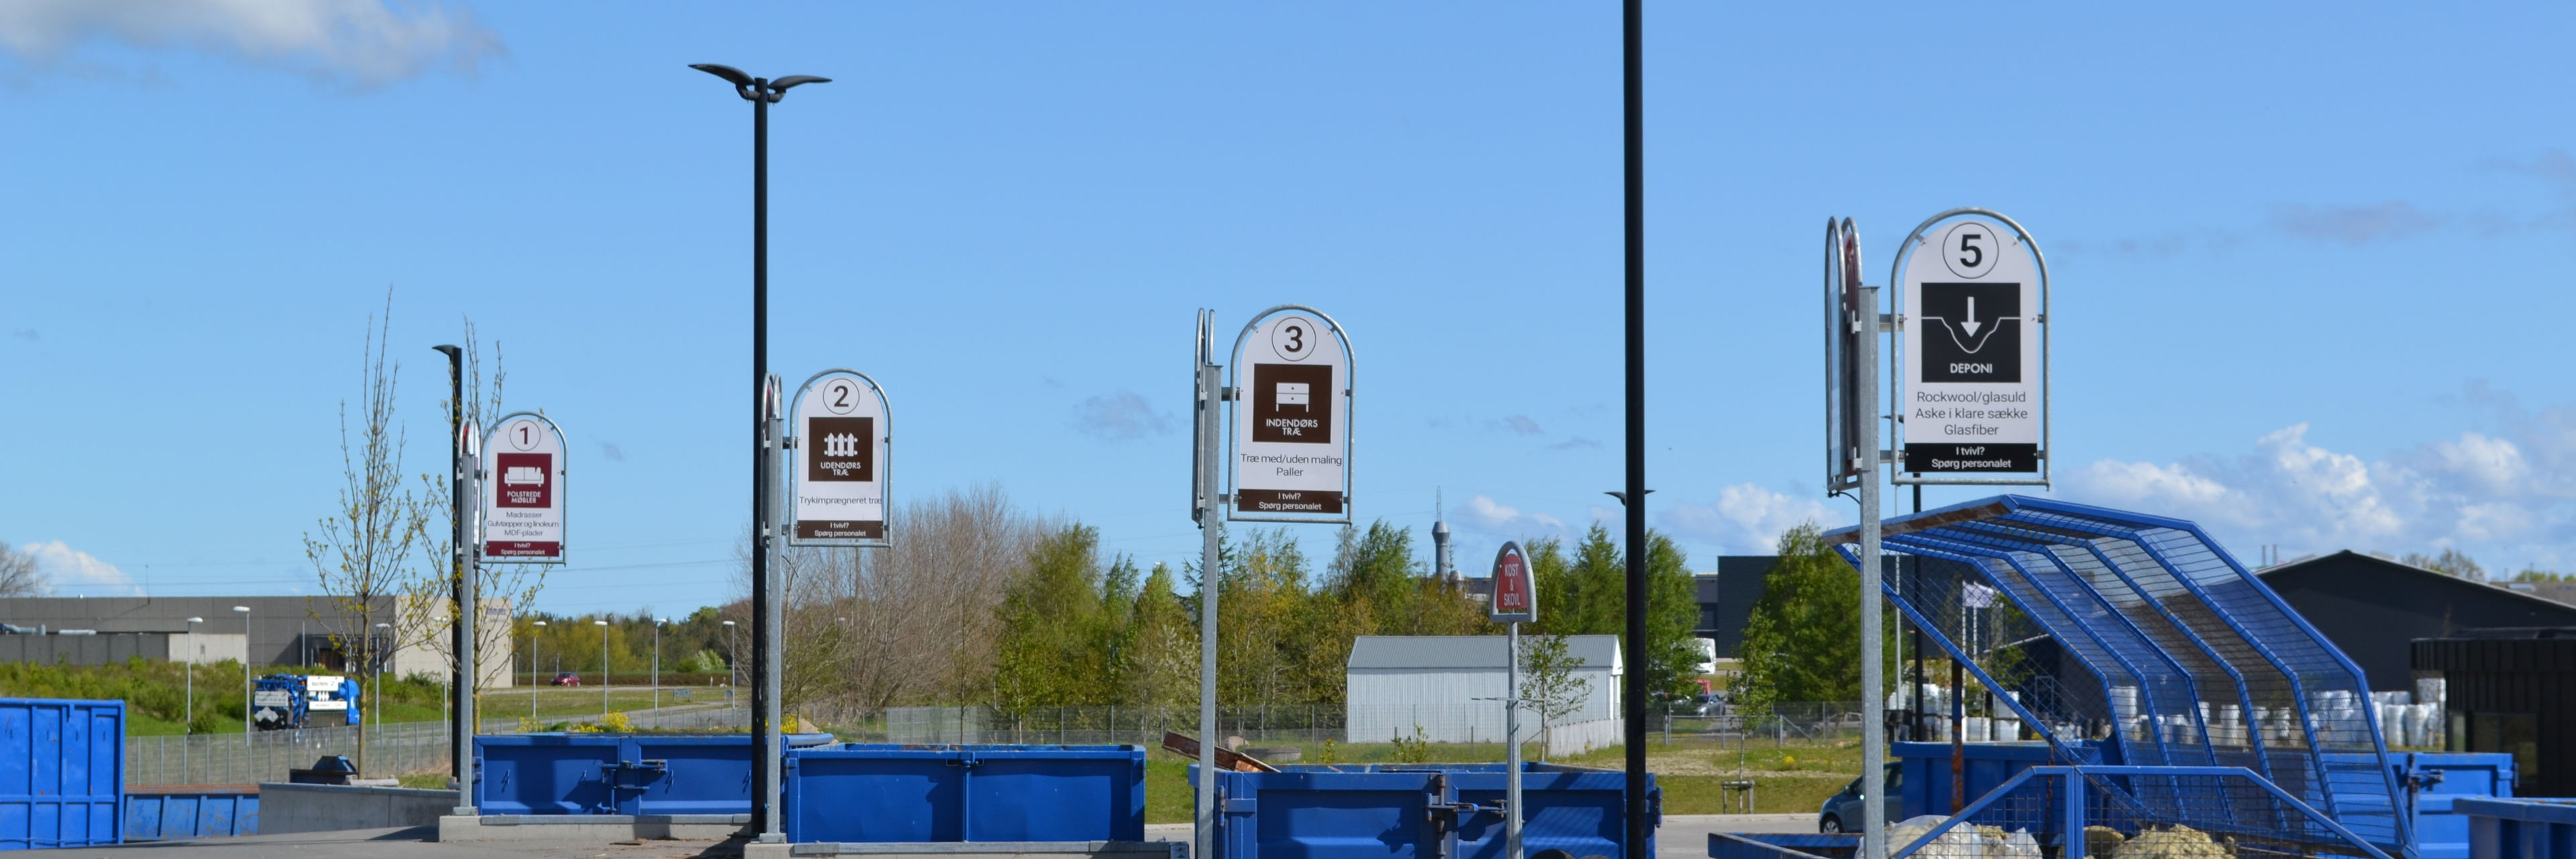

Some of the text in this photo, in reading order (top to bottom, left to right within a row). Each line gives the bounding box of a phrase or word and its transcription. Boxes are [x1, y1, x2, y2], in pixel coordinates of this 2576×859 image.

[1960, 234, 1982, 268] 5
[1284, 325, 1303, 353] 3
[1950, 363, 1992, 374] DEPONI
[834, 385, 849, 407] 2
[1917, 391, 2026, 405] Rockwool/glasuld
[1915, 407, 2028, 419] Aske i klare sække
[1266, 419, 1318, 427] INDENDØRS
[519, 426, 529, 445] 1
[1282, 427, 1302, 436] TRÆ
[1944, 424, 1998, 436] Glasfiber
[1961, 447, 1984, 455] tvivl?
[1240, 453, 1342, 466] Træ med/uden maling
[1931, 459, 2011, 470] Spørg personalet
[820, 462, 861, 470] UDENDØRS
[1276, 467, 1303, 476] Paller
[800, 496, 867, 505] Trykimprægneret
[1282, 493, 1301, 501] tvivl?
[1258, 502, 1322, 511] Spørg personalet
[1505, 564, 1519, 576] KOST
[1509, 578, 1514, 591] &
[1504, 593, 1520, 605] SKOVL
